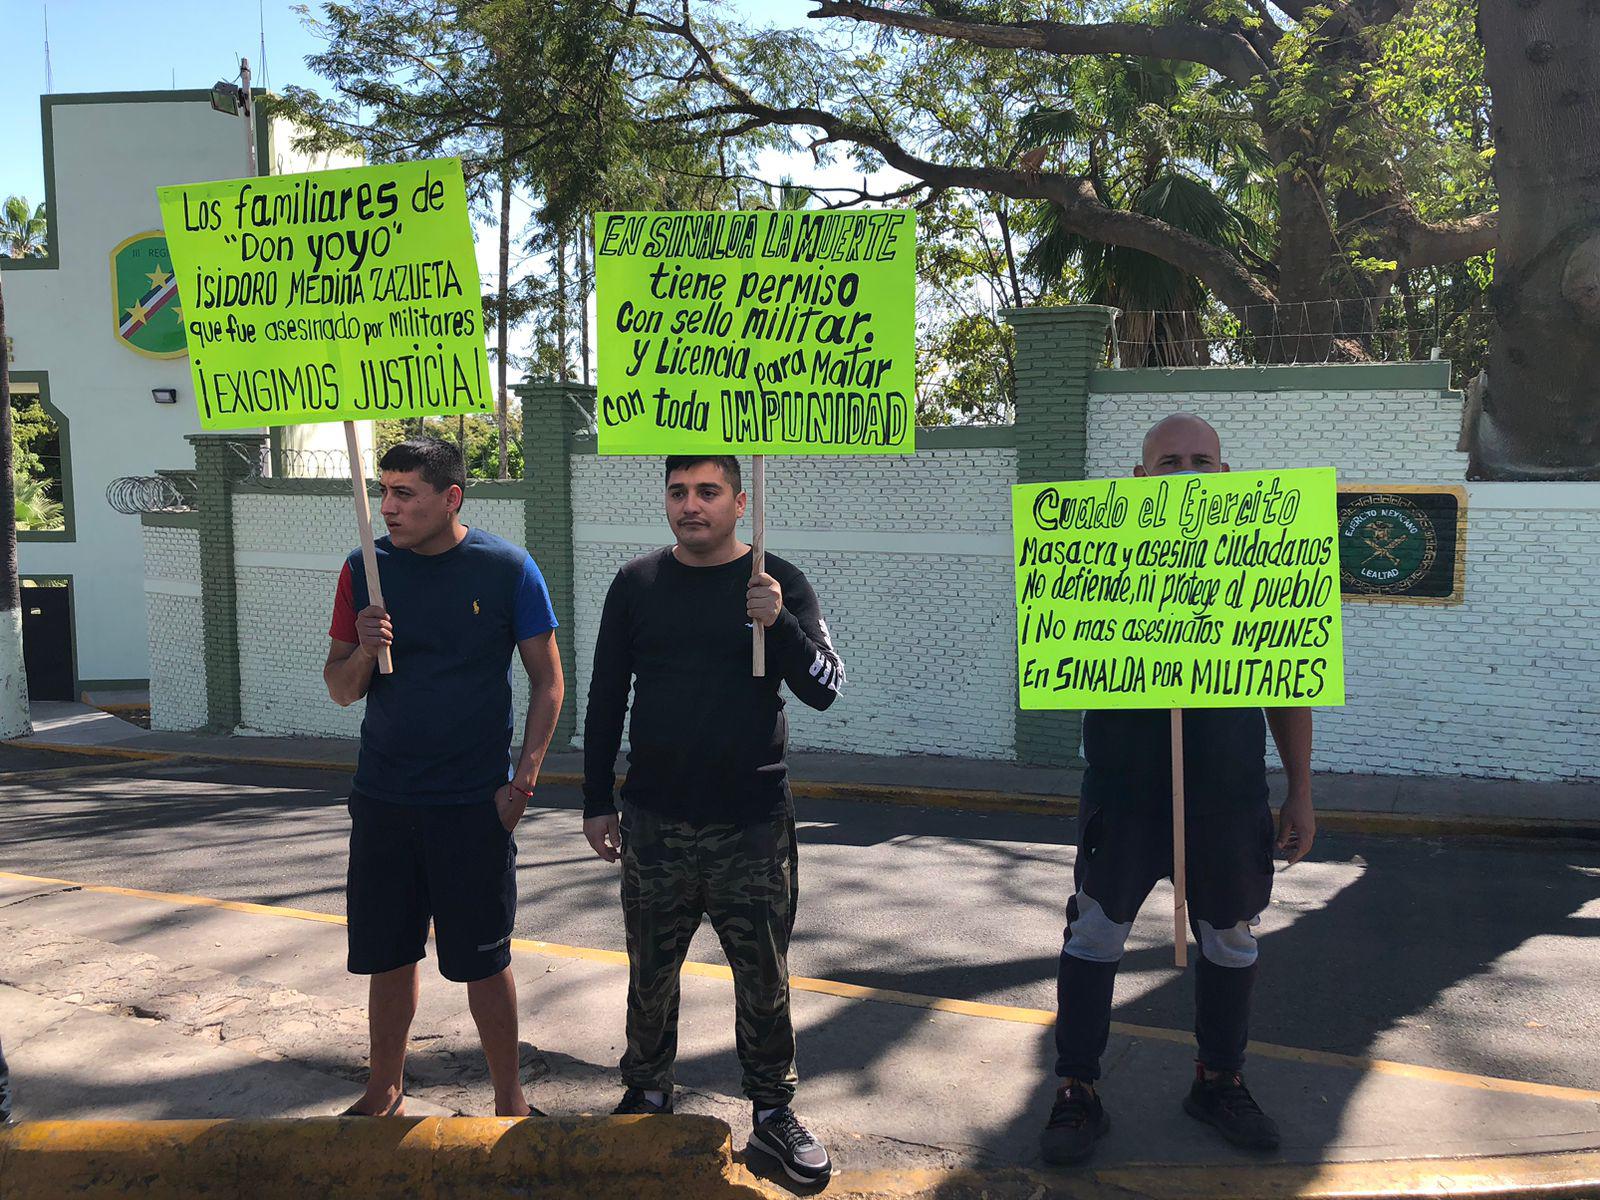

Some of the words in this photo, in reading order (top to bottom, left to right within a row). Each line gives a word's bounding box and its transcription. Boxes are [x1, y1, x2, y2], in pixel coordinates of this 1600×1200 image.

[184, 191, 222, 231] Los
[234, 178, 397, 229] familiares
[412, 170, 445, 213] de
[599, 214, 647, 256] EN
[642, 213, 758, 260] SINALOA
[761, 212, 794, 258] LA
[790, 214, 906, 262] MUERTE
[370, 260, 463, 302] ZAZUETA
[649, 262, 727, 300] tiene
[190, 321, 222, 348] que
[226, 314, 256, 343] fue
[265, 311, 360, 341] asesinado
[364, 321, 384, 346] por
[670, 301, 733, 338] sello
[754, 350, 806, 392] para
[810, 343, 892, 389] Matar
[652, 387, 710, 432] toda
[721, 389, 909, 446] IMPUNIDAD
[1033, 481, 1129, 530] Cuado
[1138, 480, 1169, 529] el
[1179, 477, 1301, 539] Ejercito
[1345, 509, 1378, 537] EJERCITO
[1381, 509, 1418, 534] MEXICANO
[1019, 537, 1118, 567] Masacra
[1122, 547, 1133, 574] y
[1136, 539, 1208, 568] asesina
[1361, 567, 1399, 580] LEALTAD
[1022, 568, 1047, 604] No
[1133, 569, 1157, 603] ni
[1157, 570, 1221, 615] protege
[1225, 570, 1246, 609] al
[1250, 567, 1332, 612] pueblo
[1073, 618, 1118, 642] mas
[1122, 613, 1224, 645] asesinatos
[1231, 615, 1333, 653] IMPUNES
[1023, 658, 1050, 689] En
[1053, 656, 1146, 693] SINALOA
[1152, 661, 1183, 687] POR
[1190, 656, 1329, 699] MILITARES
